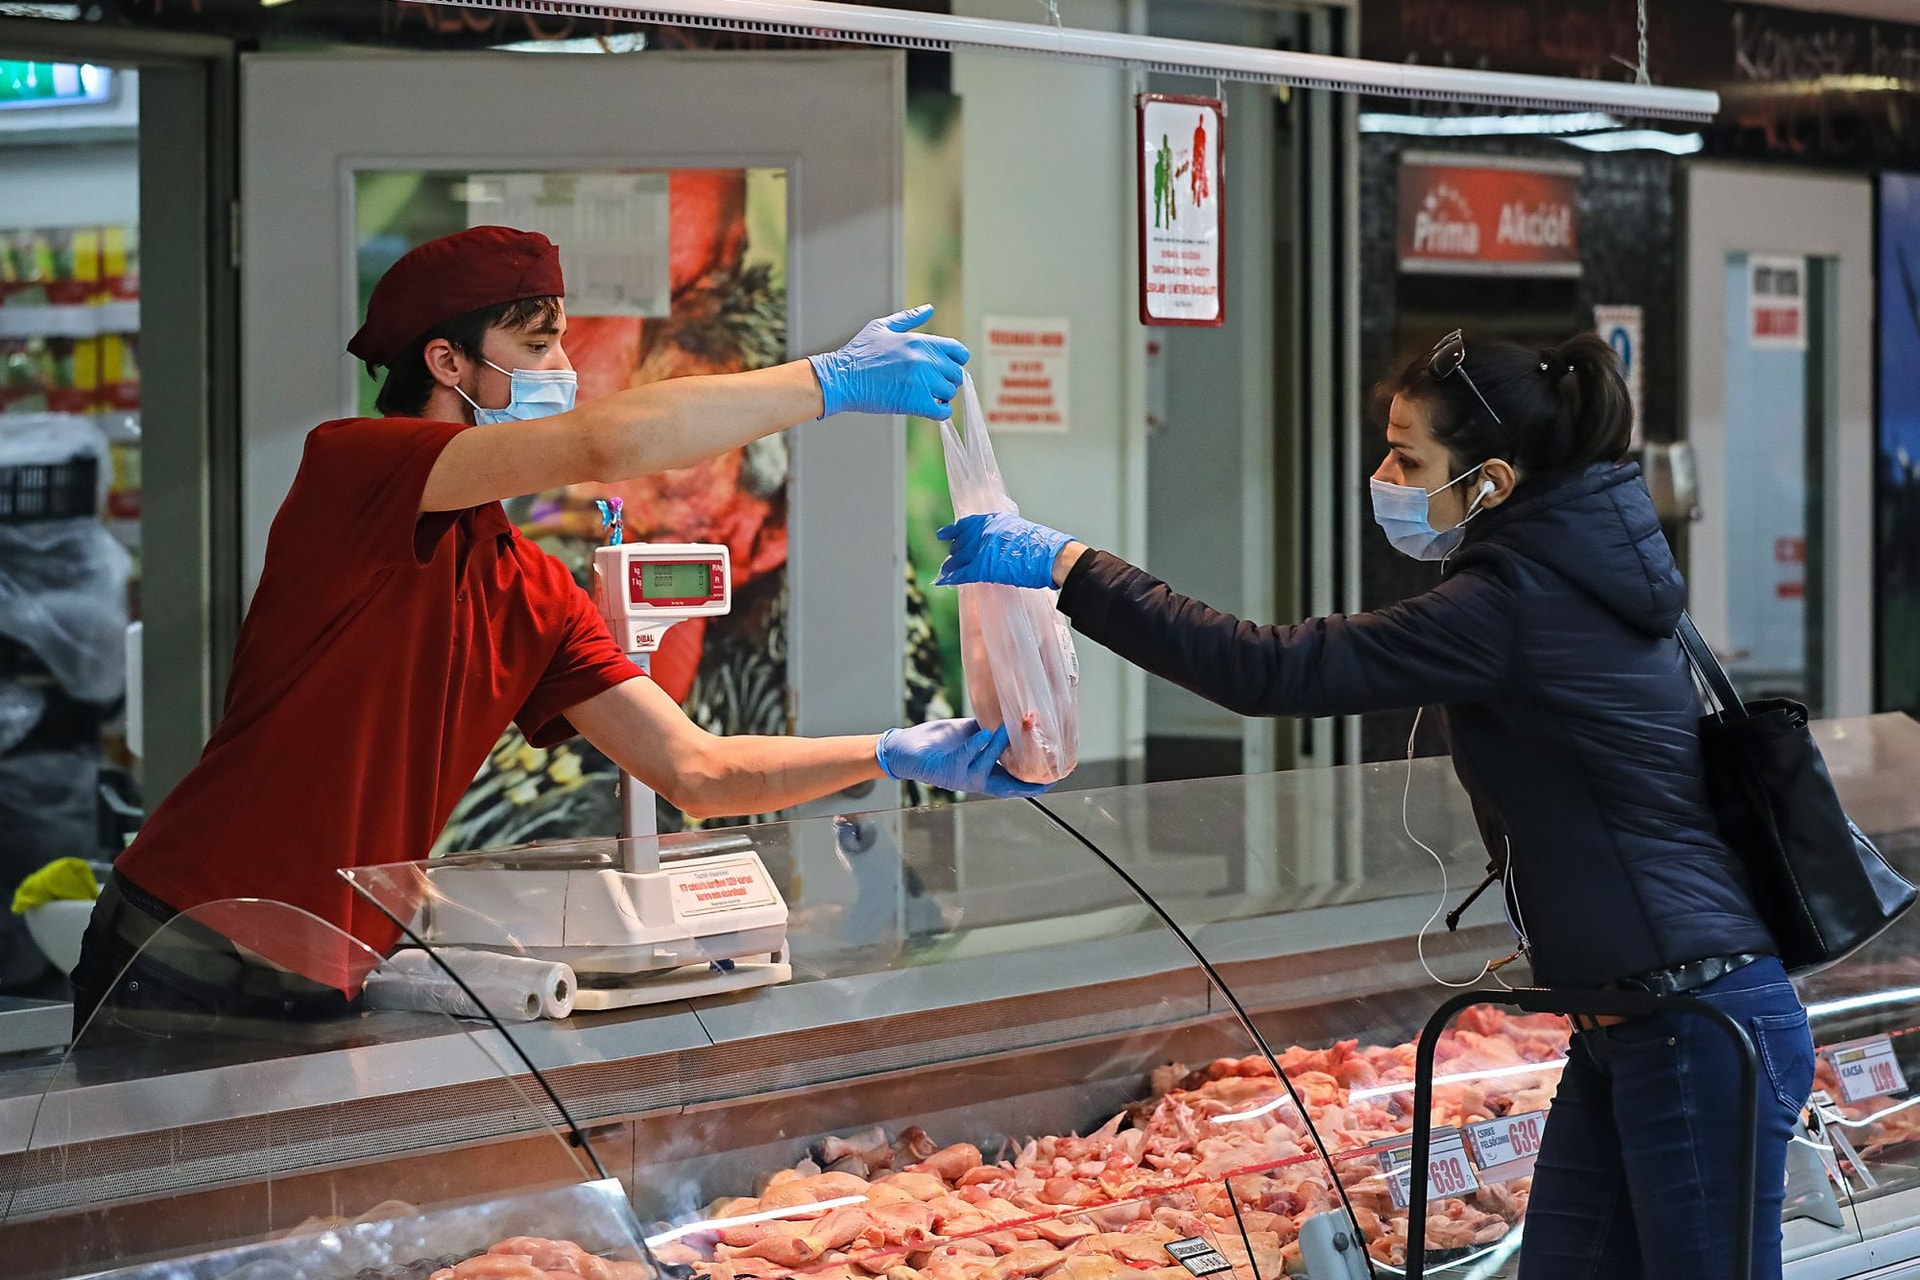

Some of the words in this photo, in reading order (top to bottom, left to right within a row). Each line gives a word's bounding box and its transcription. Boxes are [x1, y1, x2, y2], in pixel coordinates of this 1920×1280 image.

[1414, 211, 1479, 254] Prima
[636, 634, 654, 644] DIBAL
[1841, 1063, 1864, 1078] KACSA
[1477, 1126, 1495, 1139] CSIRKE
[1508, 1118, 1540, 1156] 639
[1429, 1157, 1466, 1194] 639
